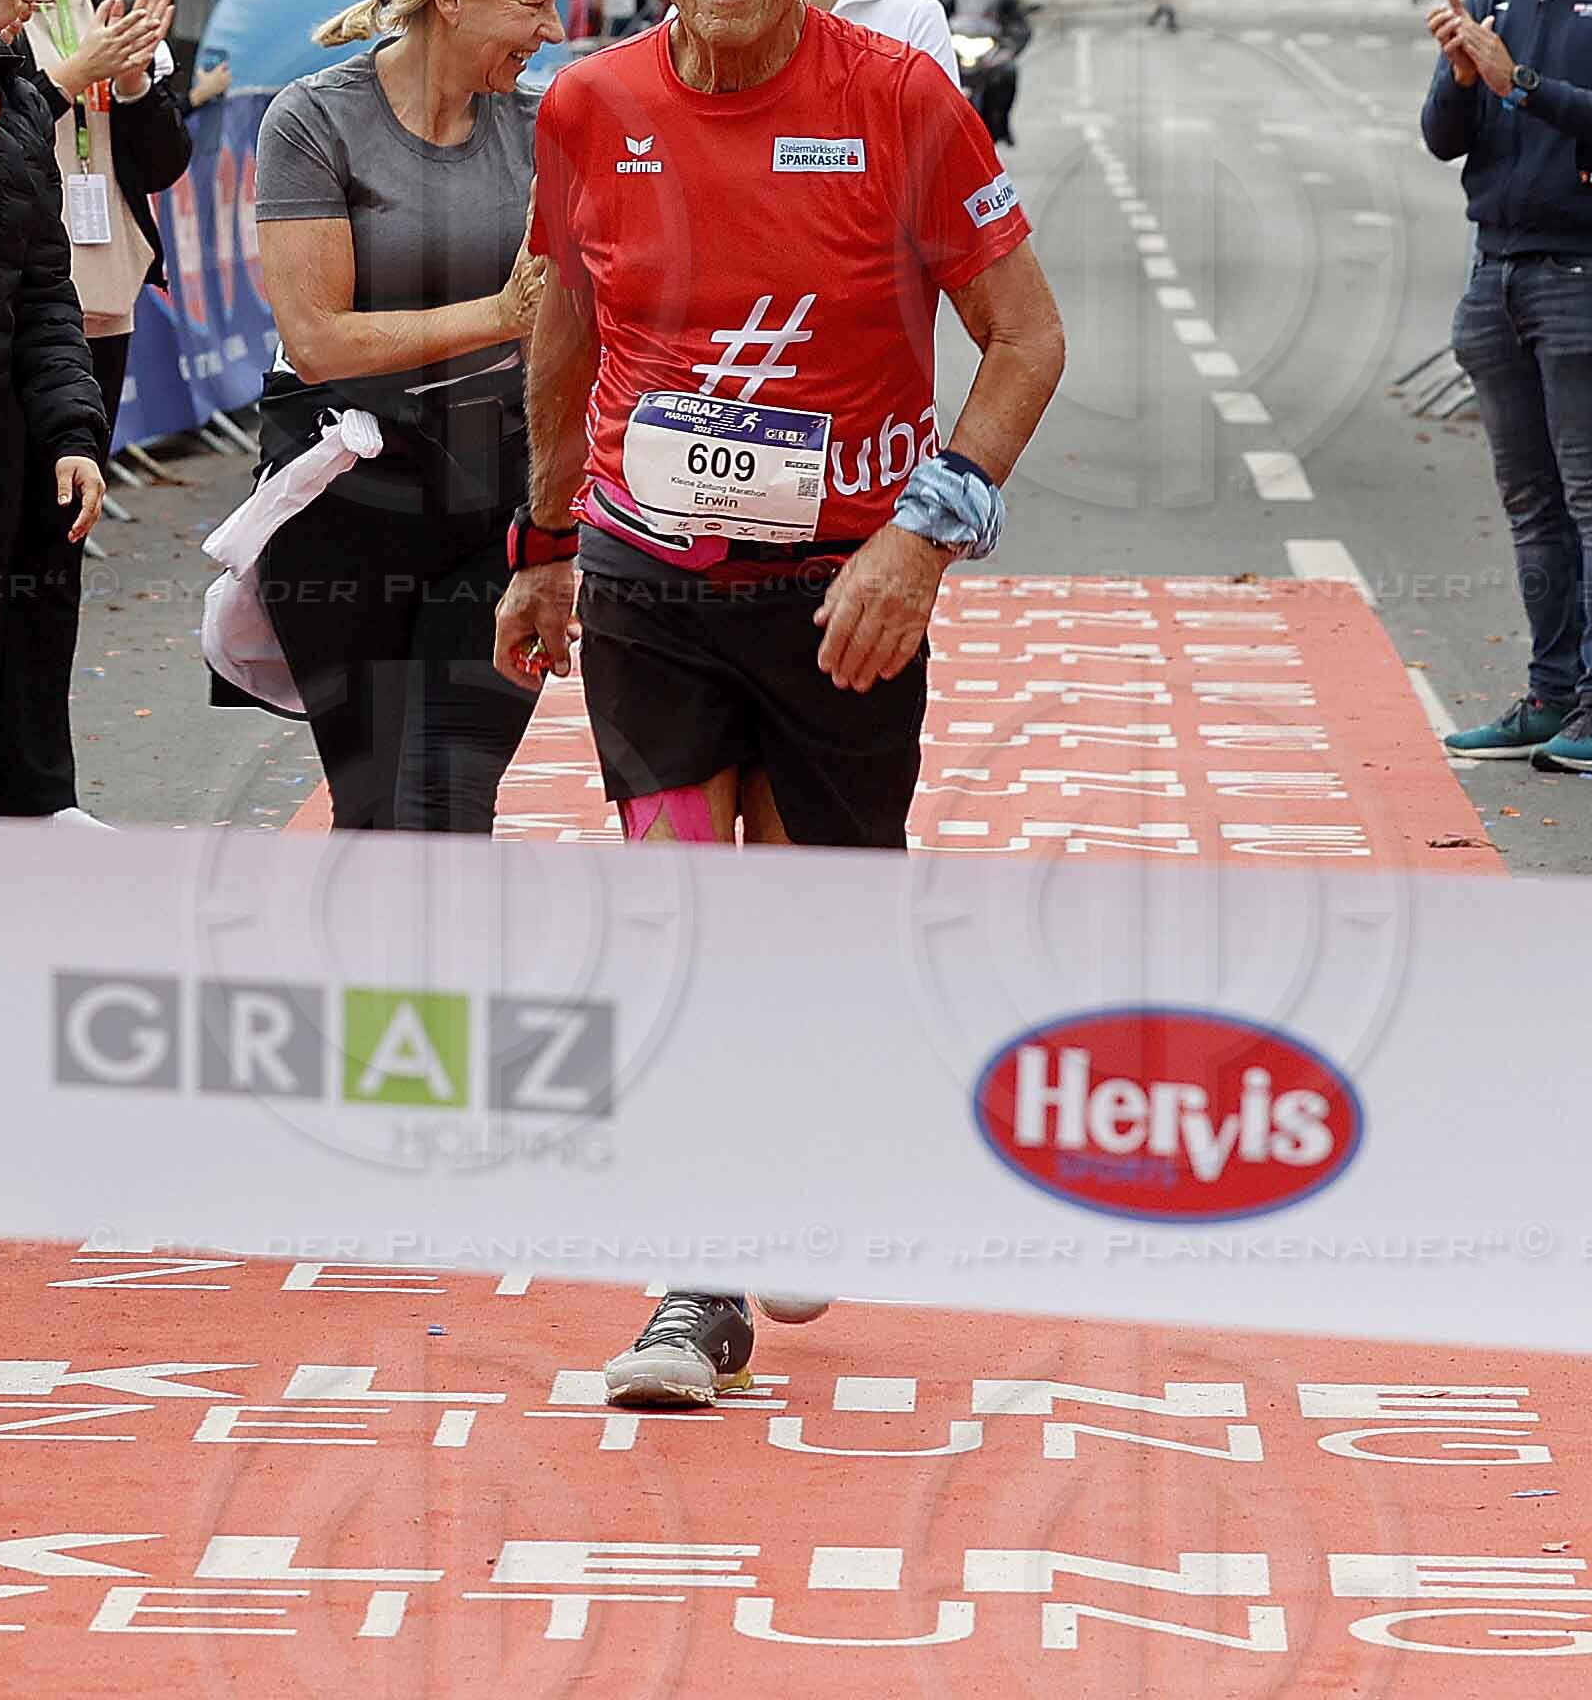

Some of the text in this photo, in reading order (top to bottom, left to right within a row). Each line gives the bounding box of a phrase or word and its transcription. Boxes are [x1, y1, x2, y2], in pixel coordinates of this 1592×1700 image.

[616, 160, 662, 173] erima
[779, 154, 846, 166] SPARKASSE
[677, 397, 724, 419] GRAZ
[687, 443, 756, 483] 609
[694, 492, 739, 509] Erwin
[63, 978, 598, 1105] GRAZ
[1013, 1042, 1336, 1183] Hervis
